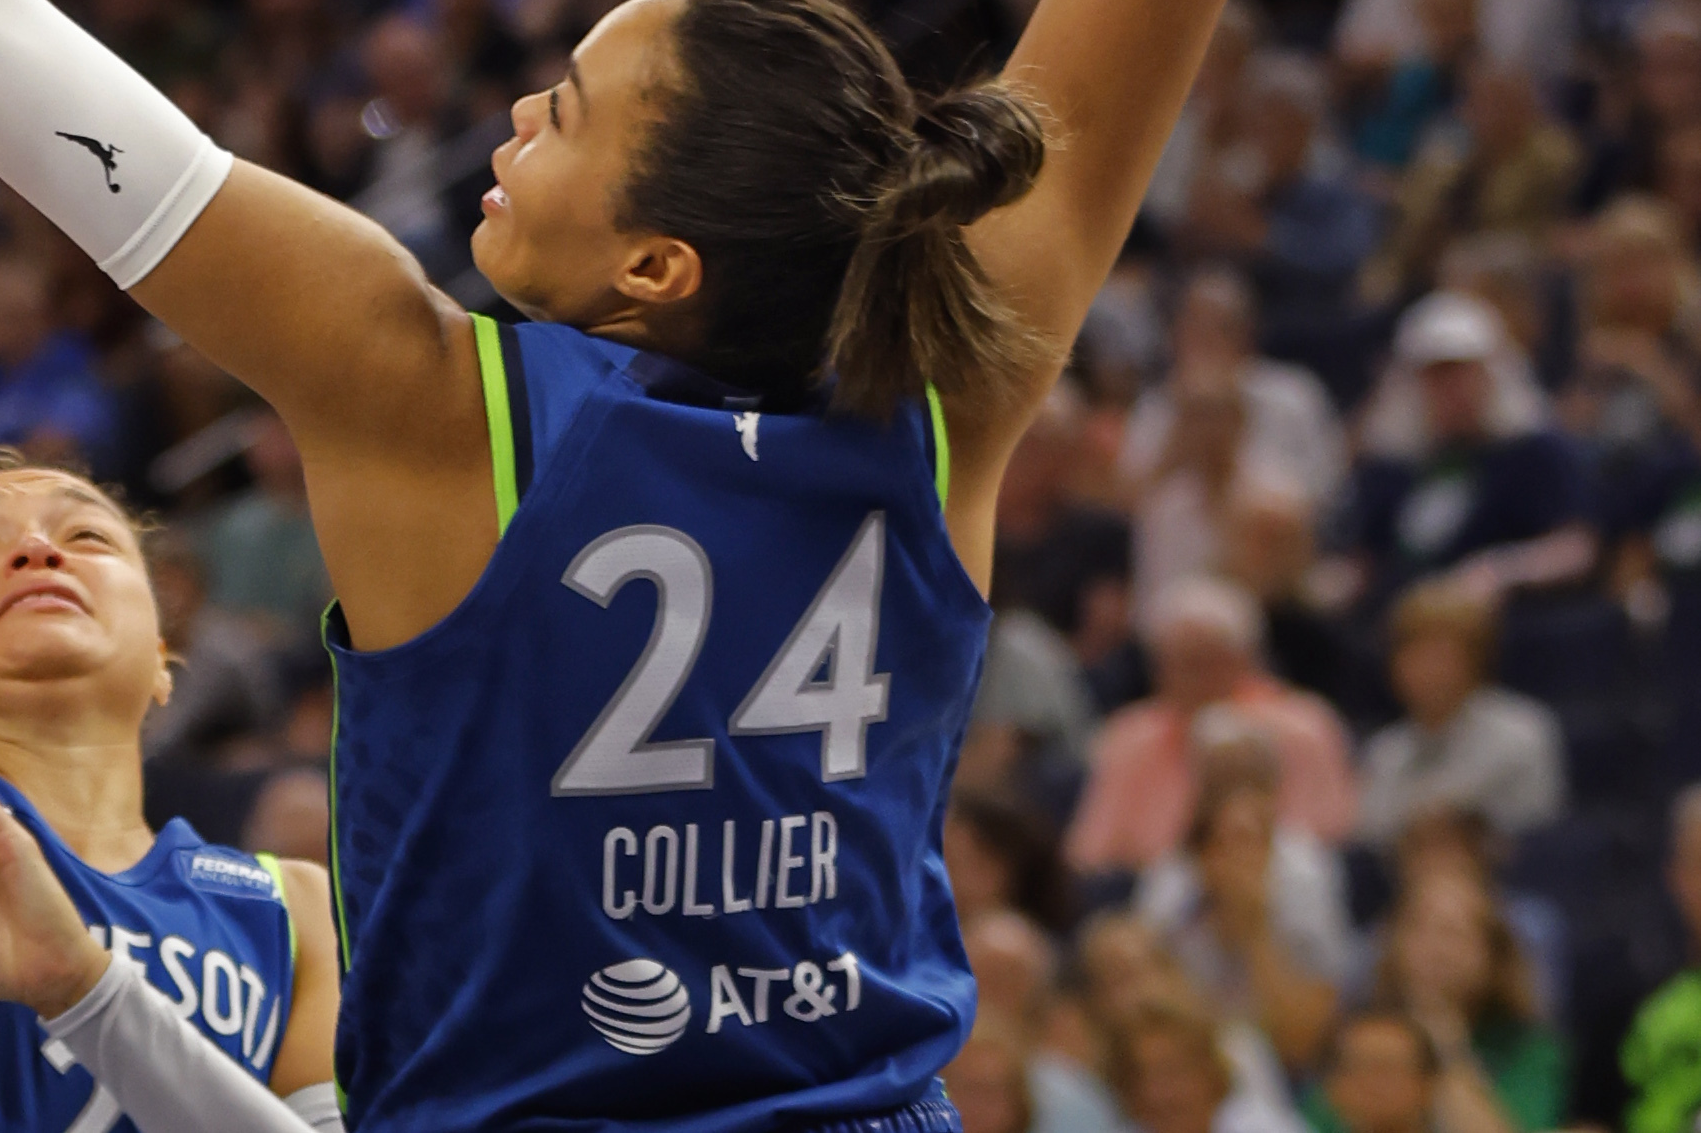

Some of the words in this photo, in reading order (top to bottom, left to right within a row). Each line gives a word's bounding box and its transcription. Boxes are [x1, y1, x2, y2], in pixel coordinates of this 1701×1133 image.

[551, 509, 892, 797] 24
[602, 810, 839, 920] COLLIER
[705, 951, 863, 1034] AT&T
